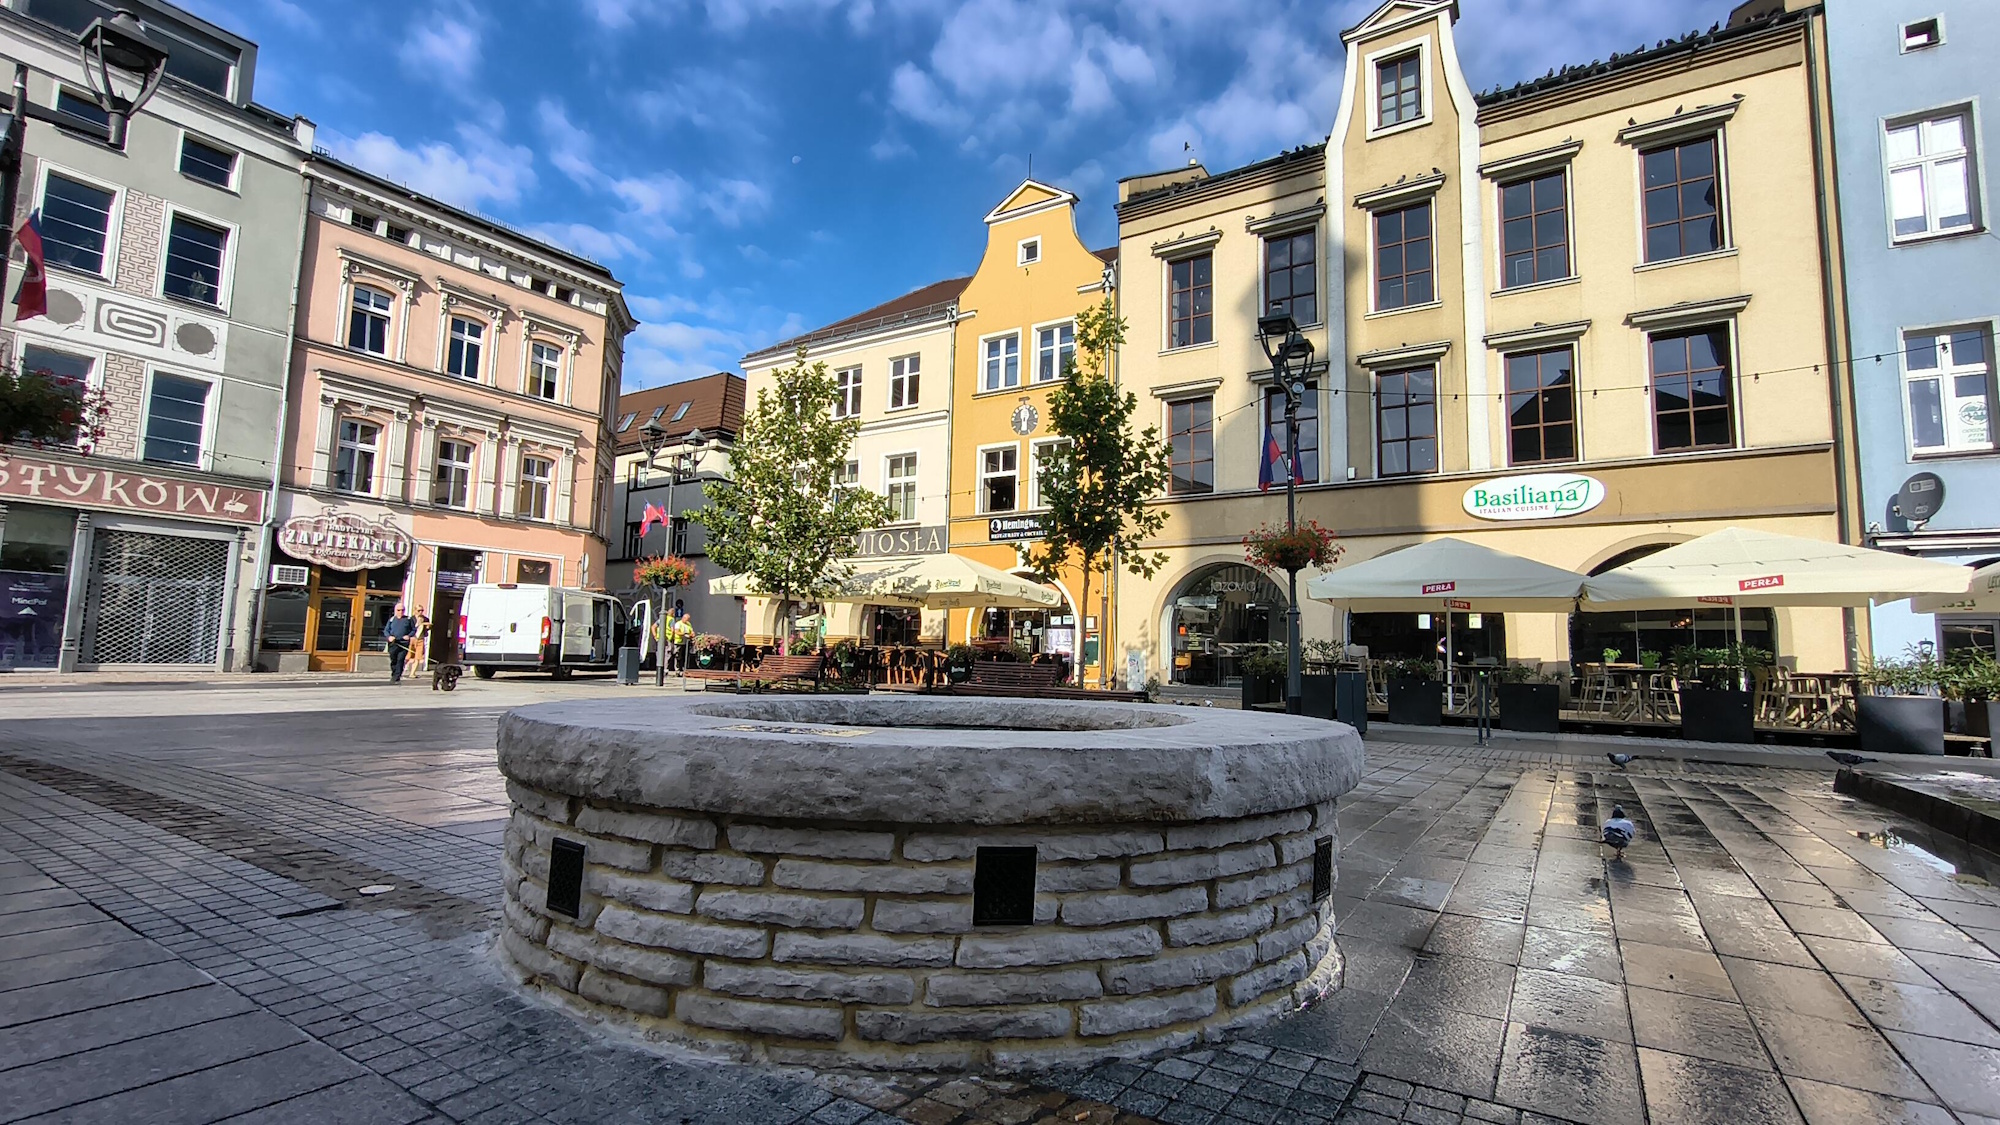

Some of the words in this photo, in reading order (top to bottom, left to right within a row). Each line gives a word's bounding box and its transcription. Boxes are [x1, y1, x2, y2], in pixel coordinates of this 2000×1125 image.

[1474, 485, 1578, 507] Basiliana
[286, 529, 405, 554] ZAPIEKANKI
[1425, 583, 1452, 593] PERŁA
[1745, 577, 1779, 588] PERŁA
